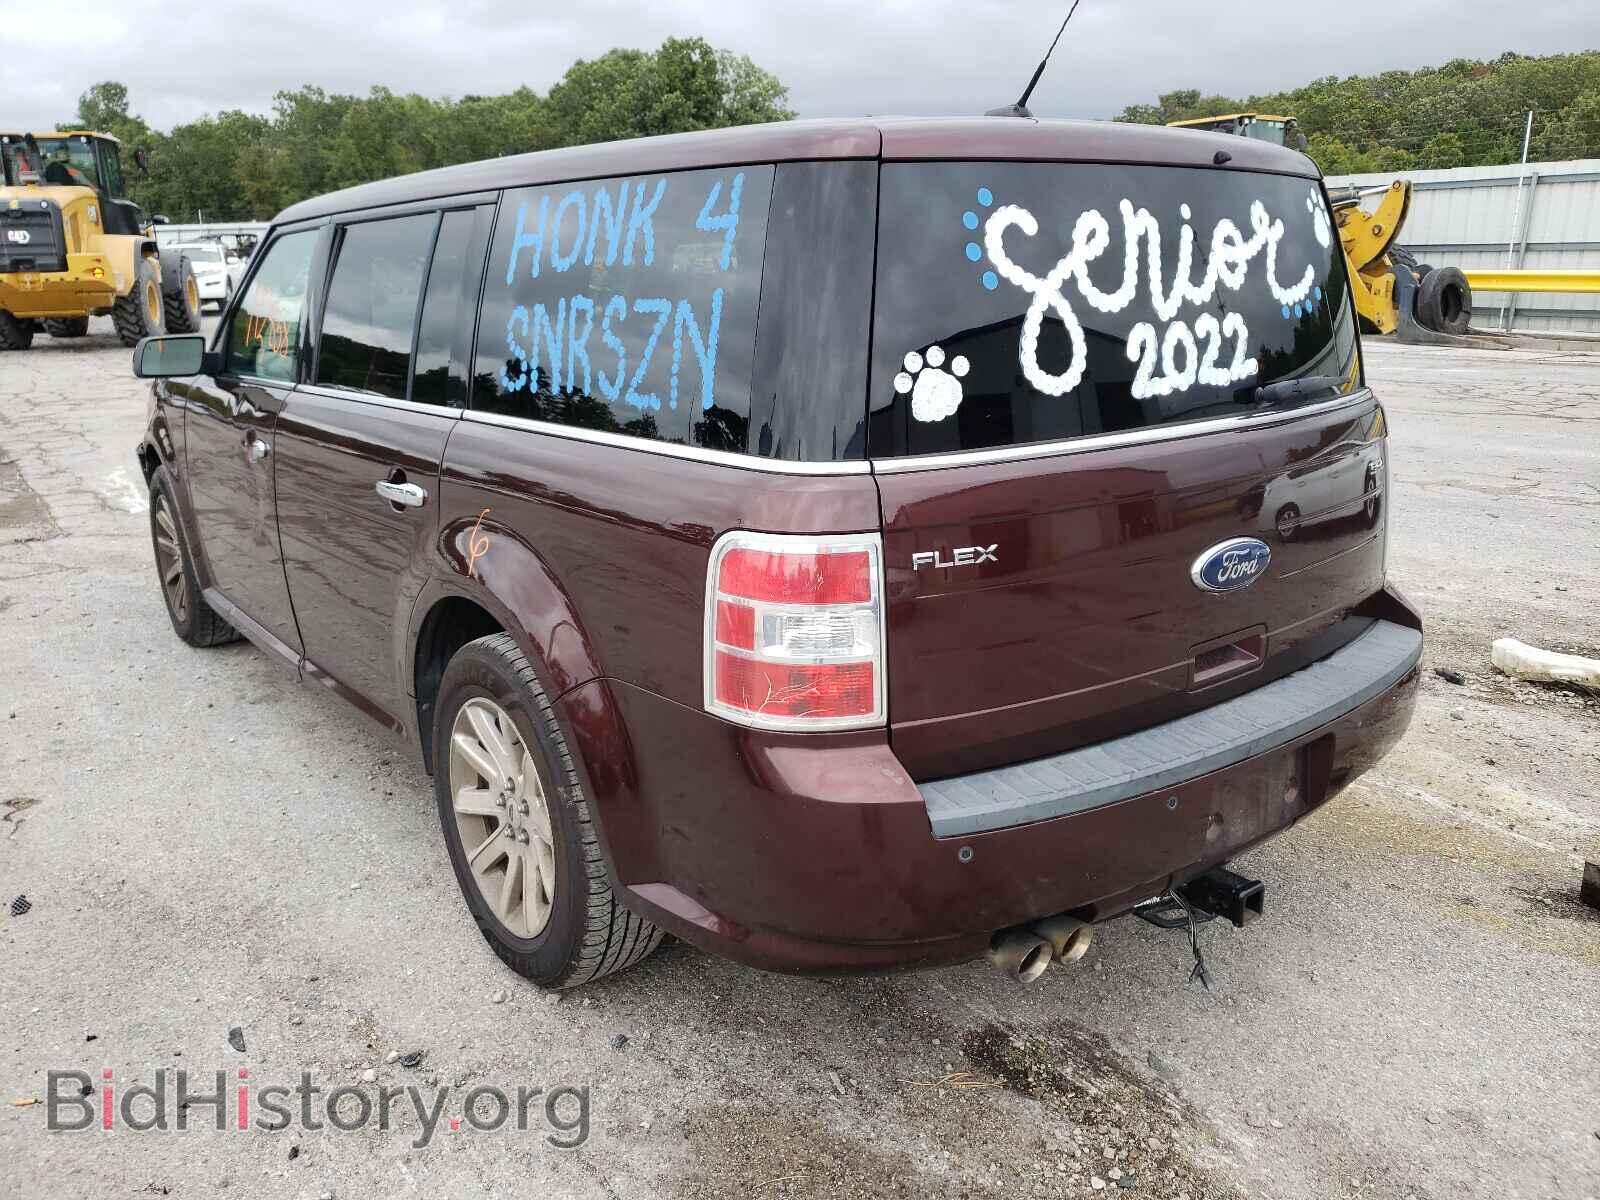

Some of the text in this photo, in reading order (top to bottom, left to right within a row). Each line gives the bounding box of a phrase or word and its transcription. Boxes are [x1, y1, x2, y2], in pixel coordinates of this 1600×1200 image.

[505, 172, 745, 286] HONK 4
[985, 198, 1315, 397] Senior
[499, 287, 724, 411] SNRSZN
[1126, 311, 1259, 400] 2022
[912, 543, 999, 571] FLEX
[1217, 548, 1260, 582] Ford
